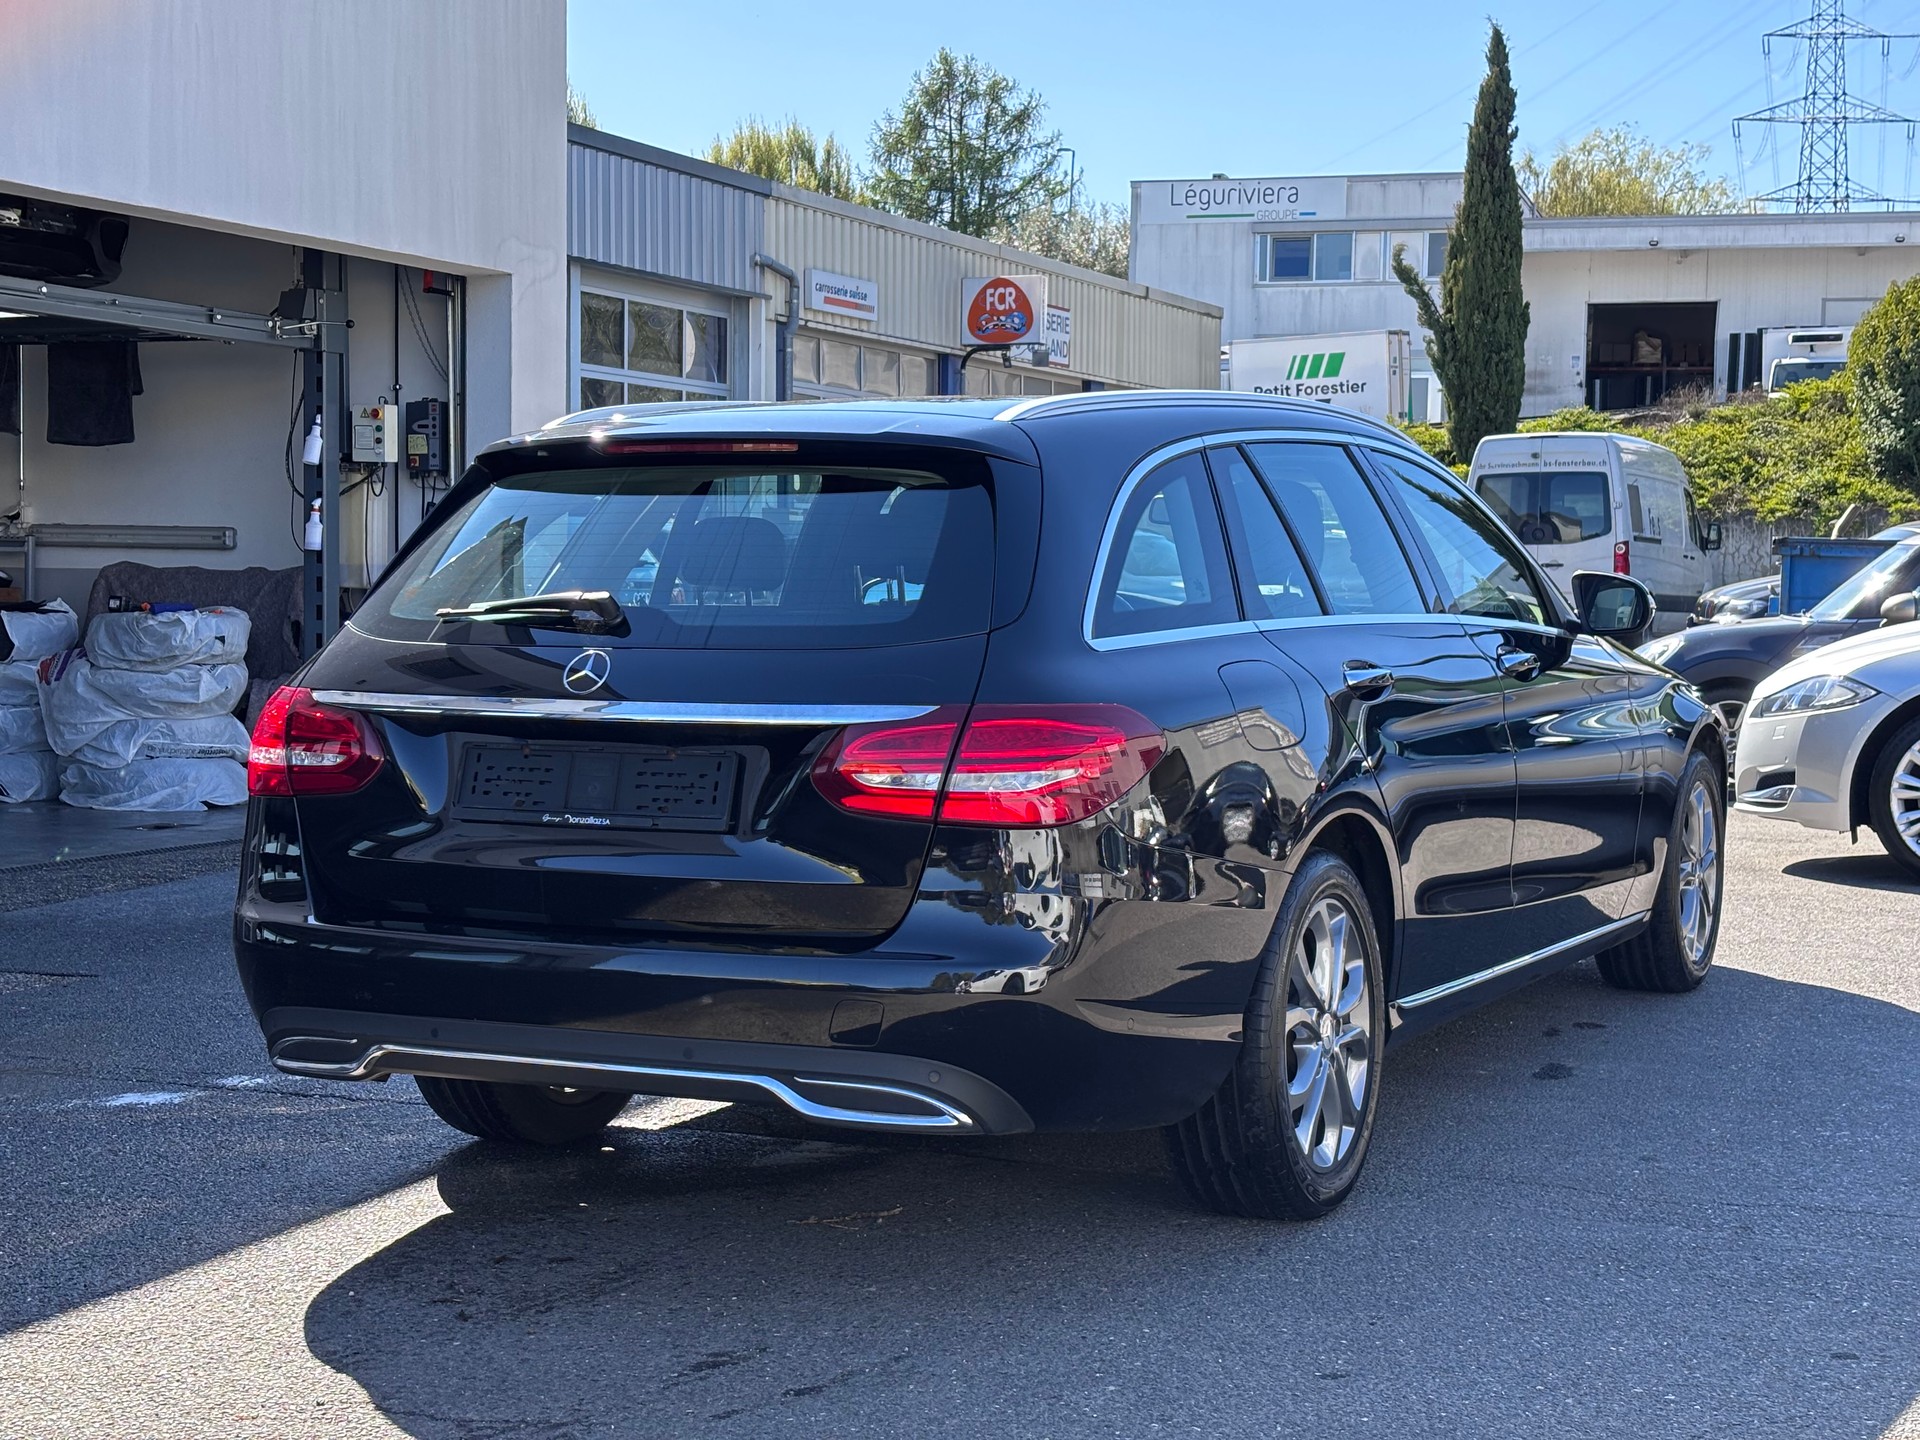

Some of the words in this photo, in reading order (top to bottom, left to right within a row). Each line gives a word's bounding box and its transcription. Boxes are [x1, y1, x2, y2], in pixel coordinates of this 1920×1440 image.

[1171, 182, 1299, 211] Léguriviera
[1256, 209, 1298, 220] GROUPE
[815, 282, 848, 298] carrosserie
[849, 286, 868, 301] suisse
[986, 287, 1016, 311] FCR
[1296, 380, 1367, 396] Forestier
[1543, 459, 1607, 468] bs-fensterbau.ch
